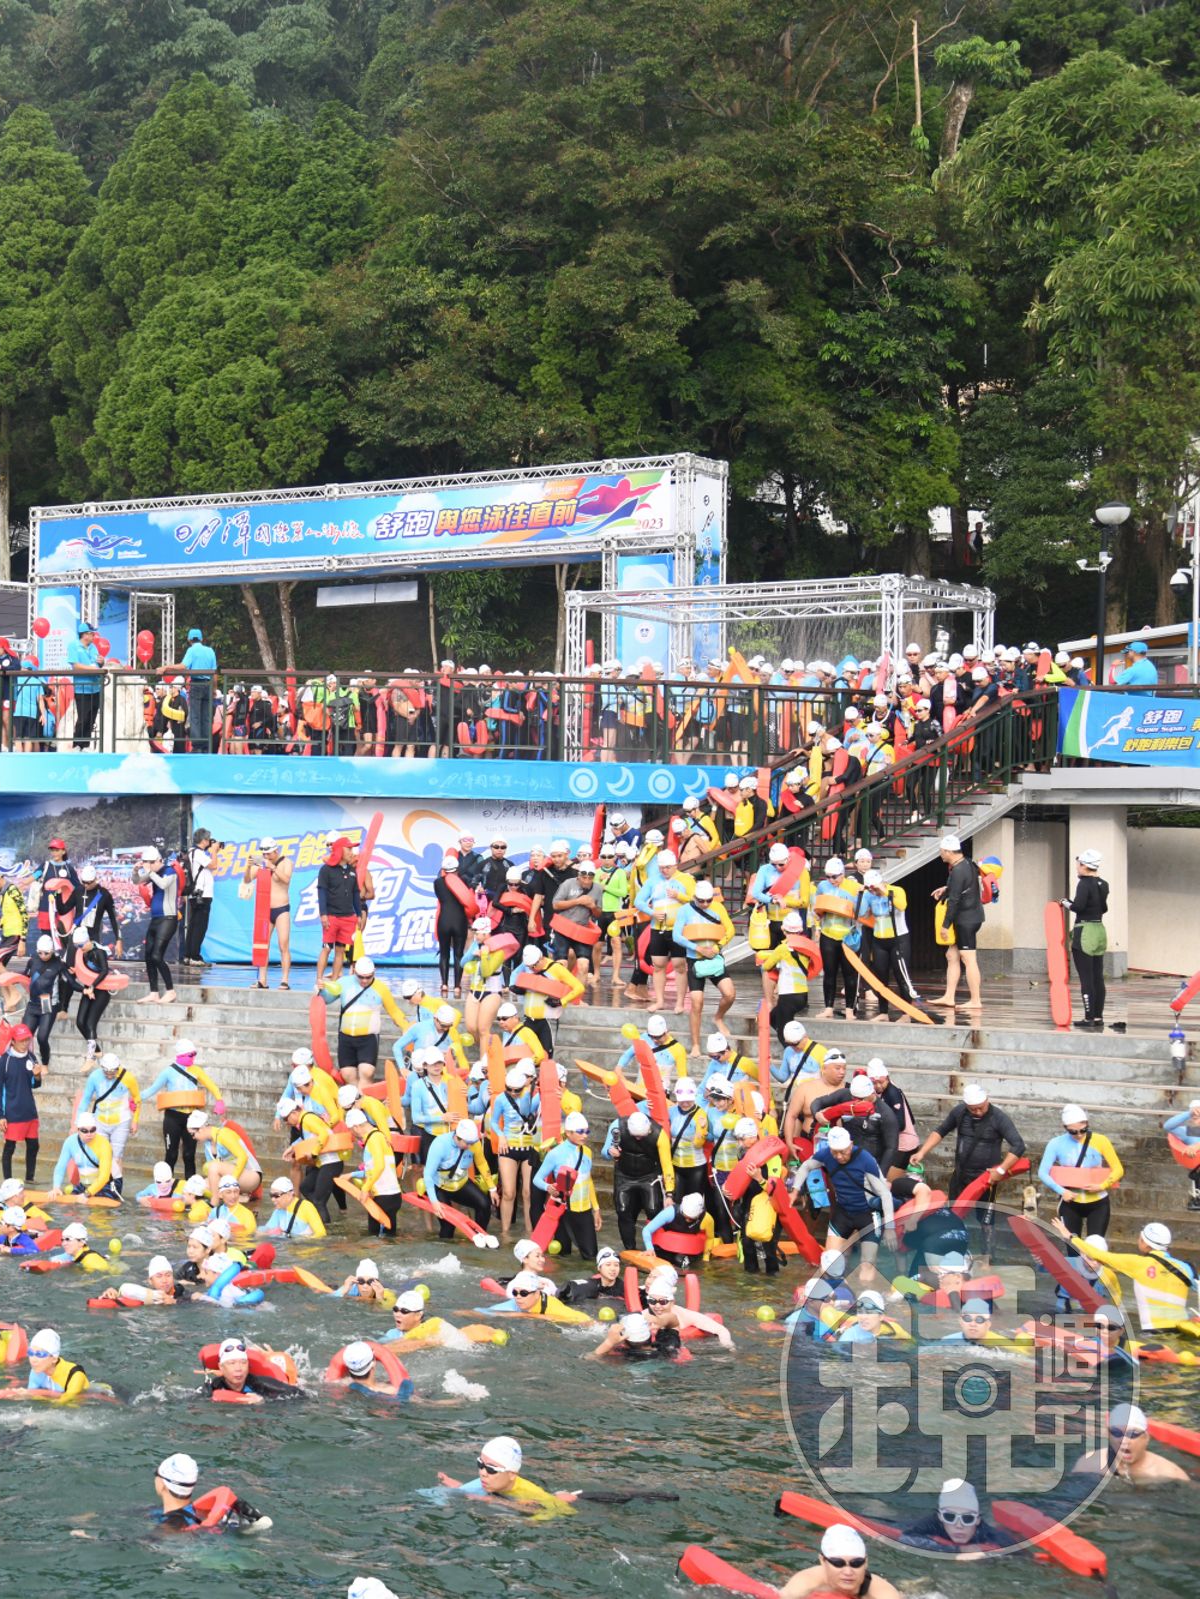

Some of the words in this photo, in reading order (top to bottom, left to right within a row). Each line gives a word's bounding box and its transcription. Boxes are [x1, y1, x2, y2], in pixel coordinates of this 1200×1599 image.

[375, 510, 434, 540] 舒跑
[435, 499, 580, 537] 與您泳往直前
[635, 517, 664, 530] 2023
[1143, 710, 1184, 725] 舒跑
